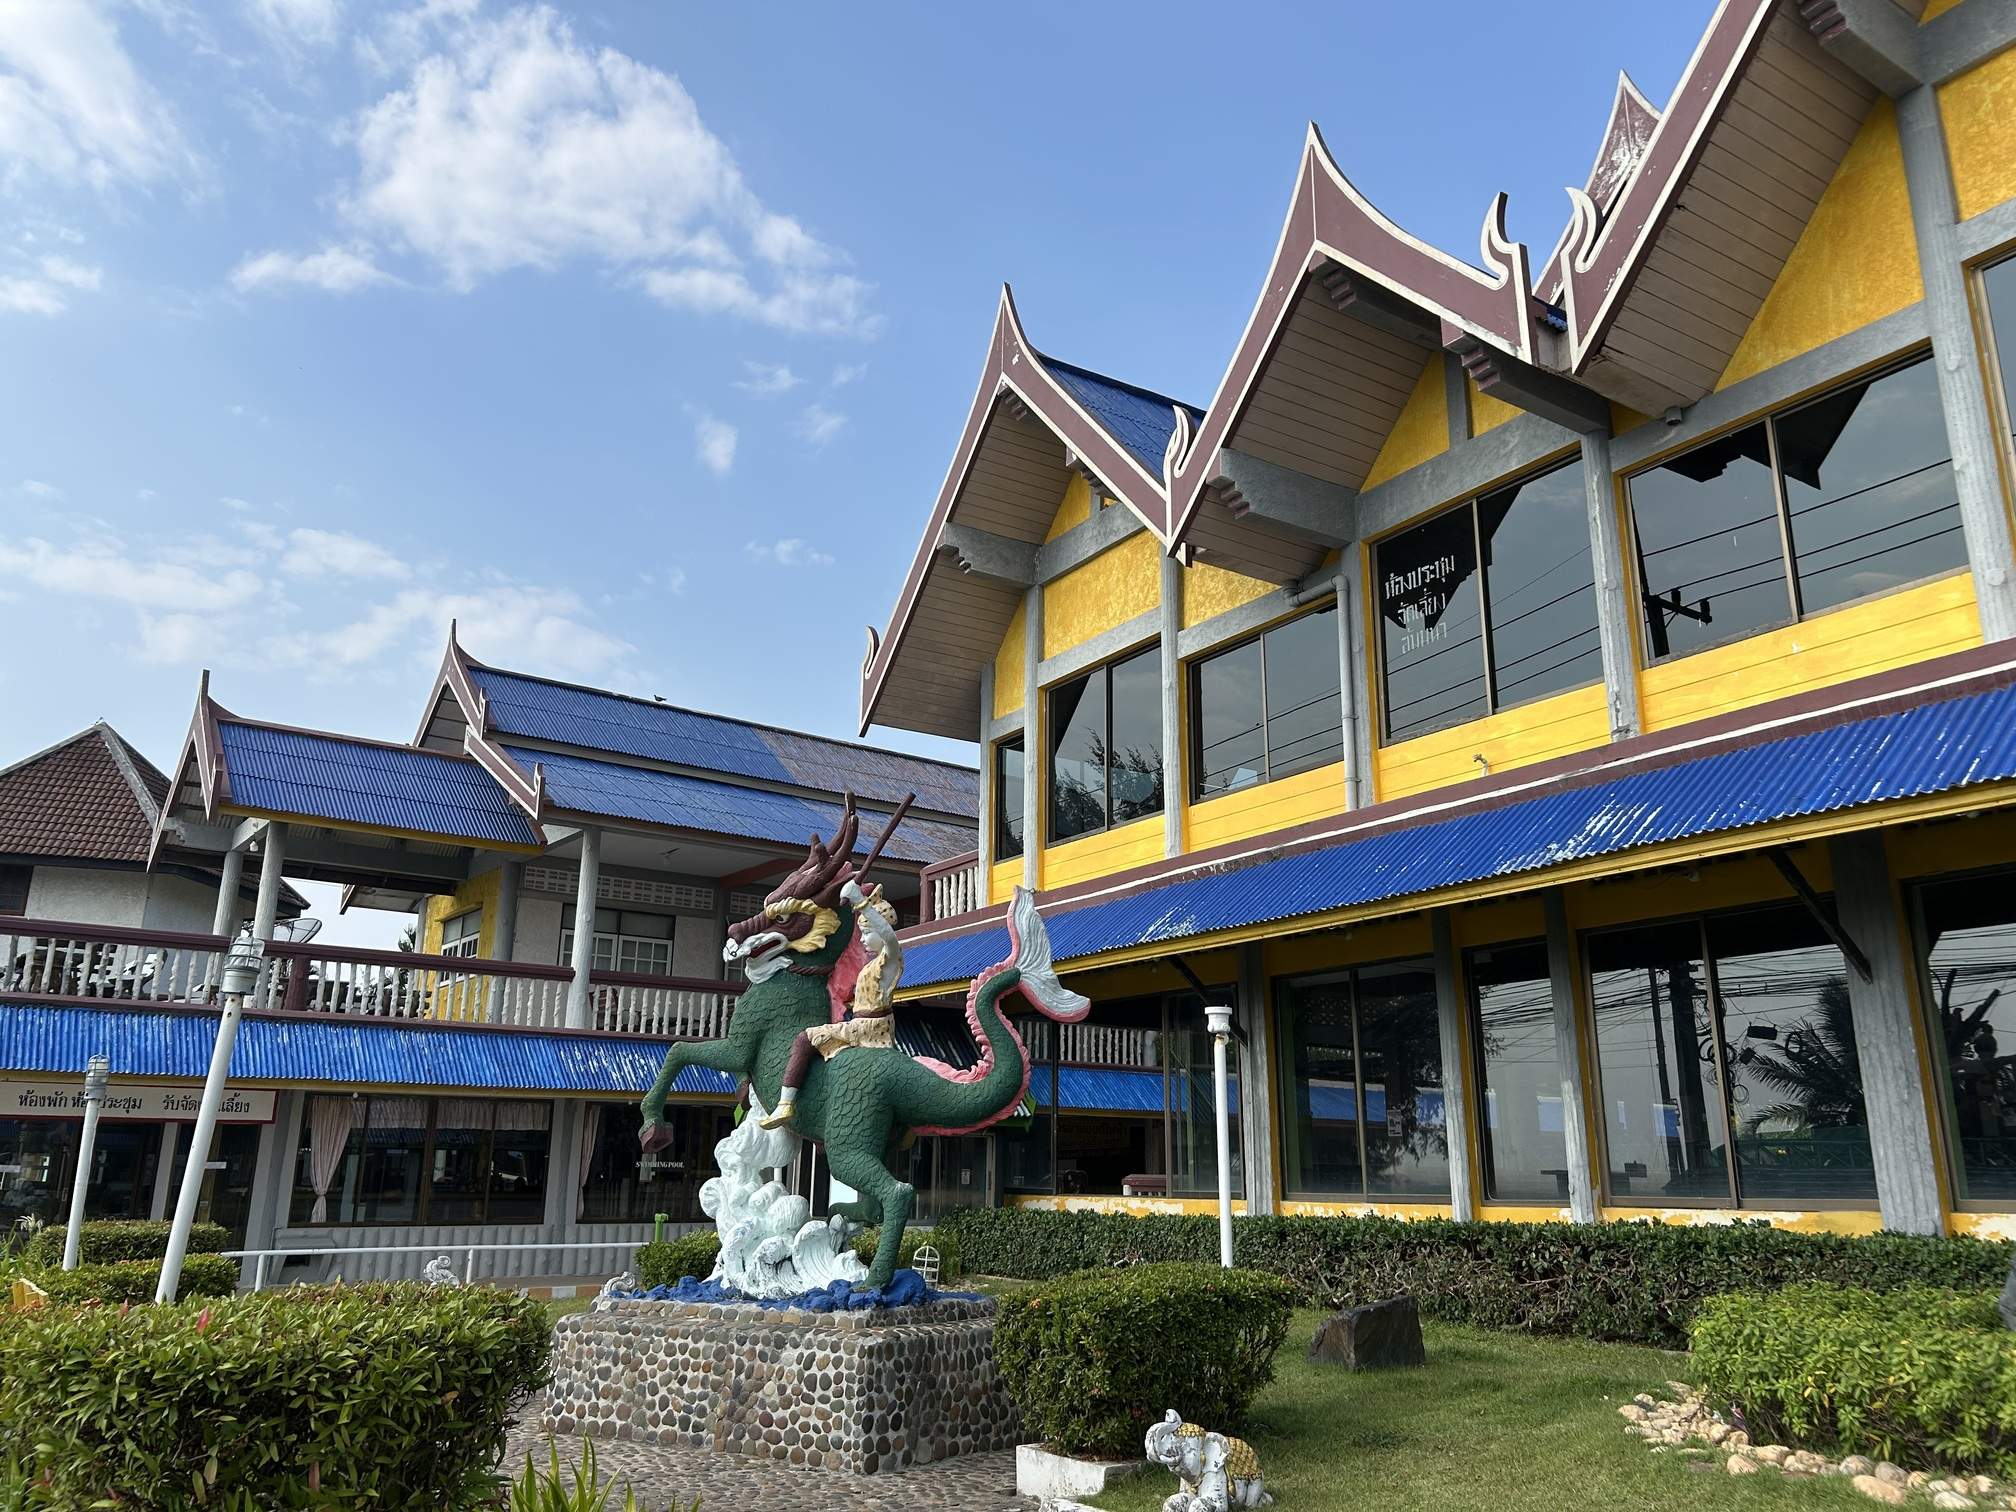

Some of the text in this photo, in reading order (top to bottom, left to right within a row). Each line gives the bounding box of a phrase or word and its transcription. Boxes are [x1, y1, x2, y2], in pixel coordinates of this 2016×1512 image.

[18, 1089, 68, 1109] ห้องพัก
[71, 1091, 143, 1114] ห้อประชุม
